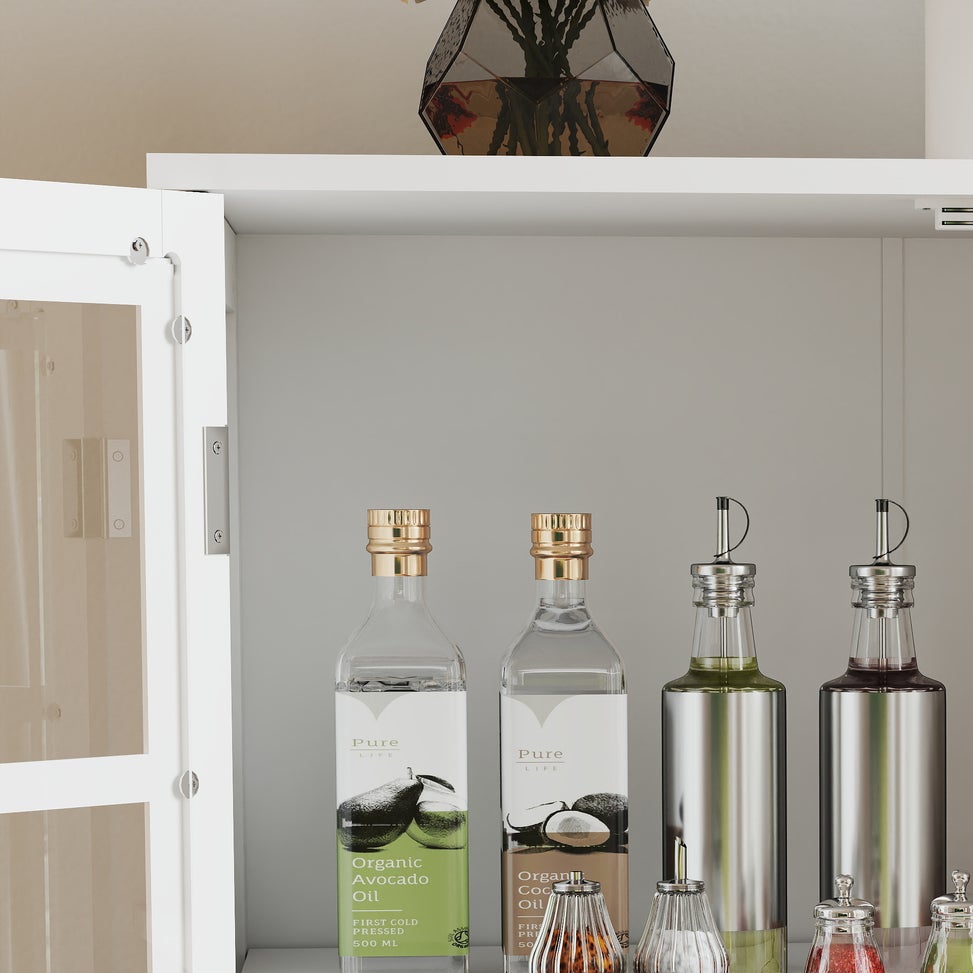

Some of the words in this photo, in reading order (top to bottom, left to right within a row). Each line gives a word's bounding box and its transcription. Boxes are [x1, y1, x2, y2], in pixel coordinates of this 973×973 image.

[352, 738, 399, 747] Pure
[518, 749, 564, 759] Pure
[352, 857, 423, 871] Organic
[352, 873, 429, 885] Avocado
[518, 871, 584, 883] Organ
[352, 890, 380, 902] Oil
[518, 899, 544, 910] Oil
[390, 918, 419, 926] COLD
[353, 927, 405, 935] PRESSED
[353, 940, 377, 948] 500
